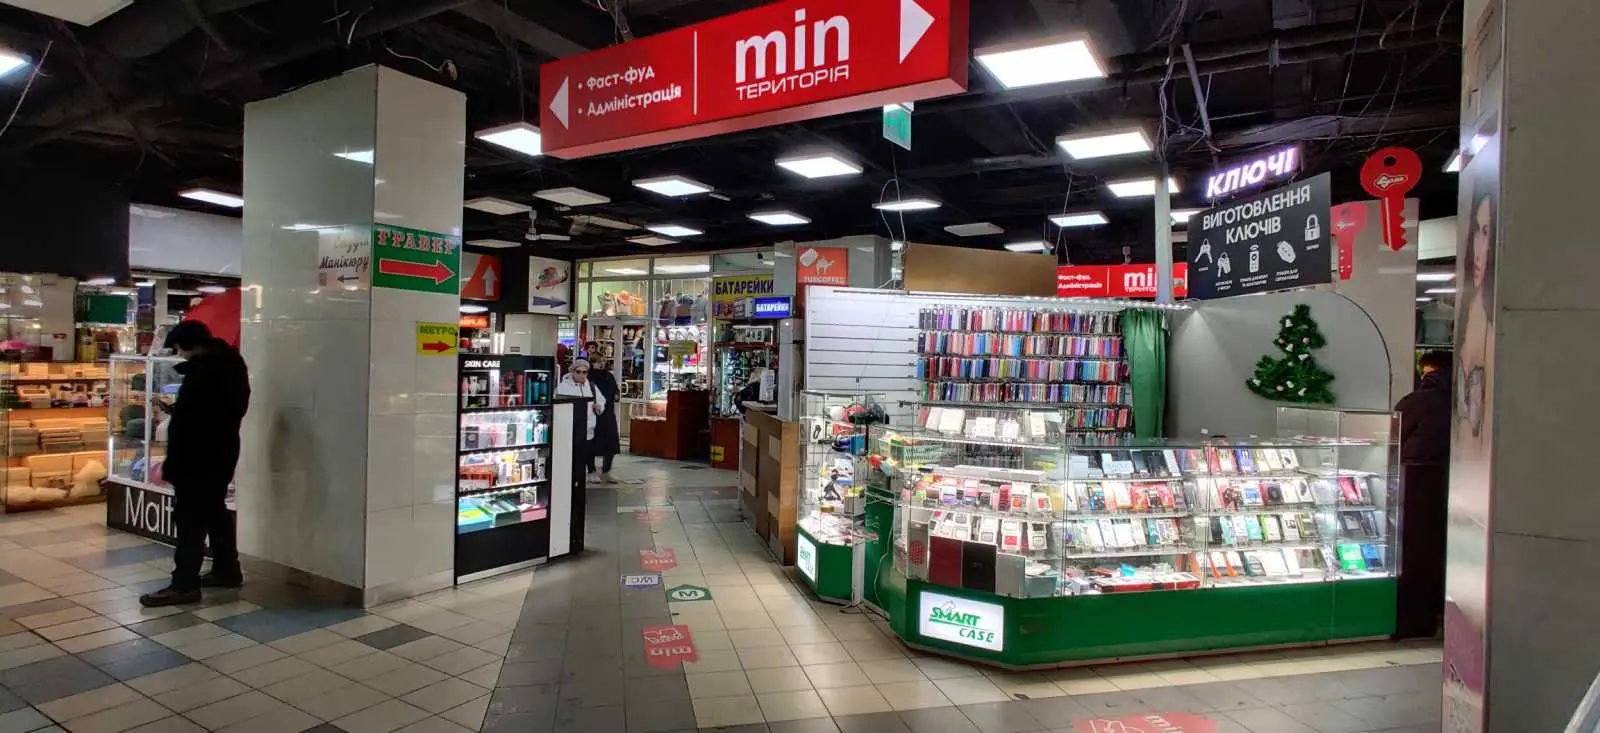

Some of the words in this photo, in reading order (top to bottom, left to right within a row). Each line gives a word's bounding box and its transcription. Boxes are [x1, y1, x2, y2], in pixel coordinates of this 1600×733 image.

[734, 8, 851, 83] min
[586, 65, 655, 91] Фаст-фуд
[735, 65, 850, 101] ТЕРИТОРІЯ
[586, 85, 682, 117] Адміністрація
[1206, 147, 1298, 198] КЛЮЧІ
[1202, 184, 1311, 231] ВИГОТОВЛЕННЯ
[1225, 216, 1282, 245] КЛЮЧІВ
[715, 277, 774, 296] БАТАРЕЙКИ
[1124, 267, 1157, 288] mi
[419, 324, 456, 335] МЕТРО
[464, 360, 481, 368] SKIN
[482, 360, 501, 368] CARE
[124, 486, 178, 538] Malt
[929, 605, 981, 627] SMART
[959, 627, 995, 644] CASE
